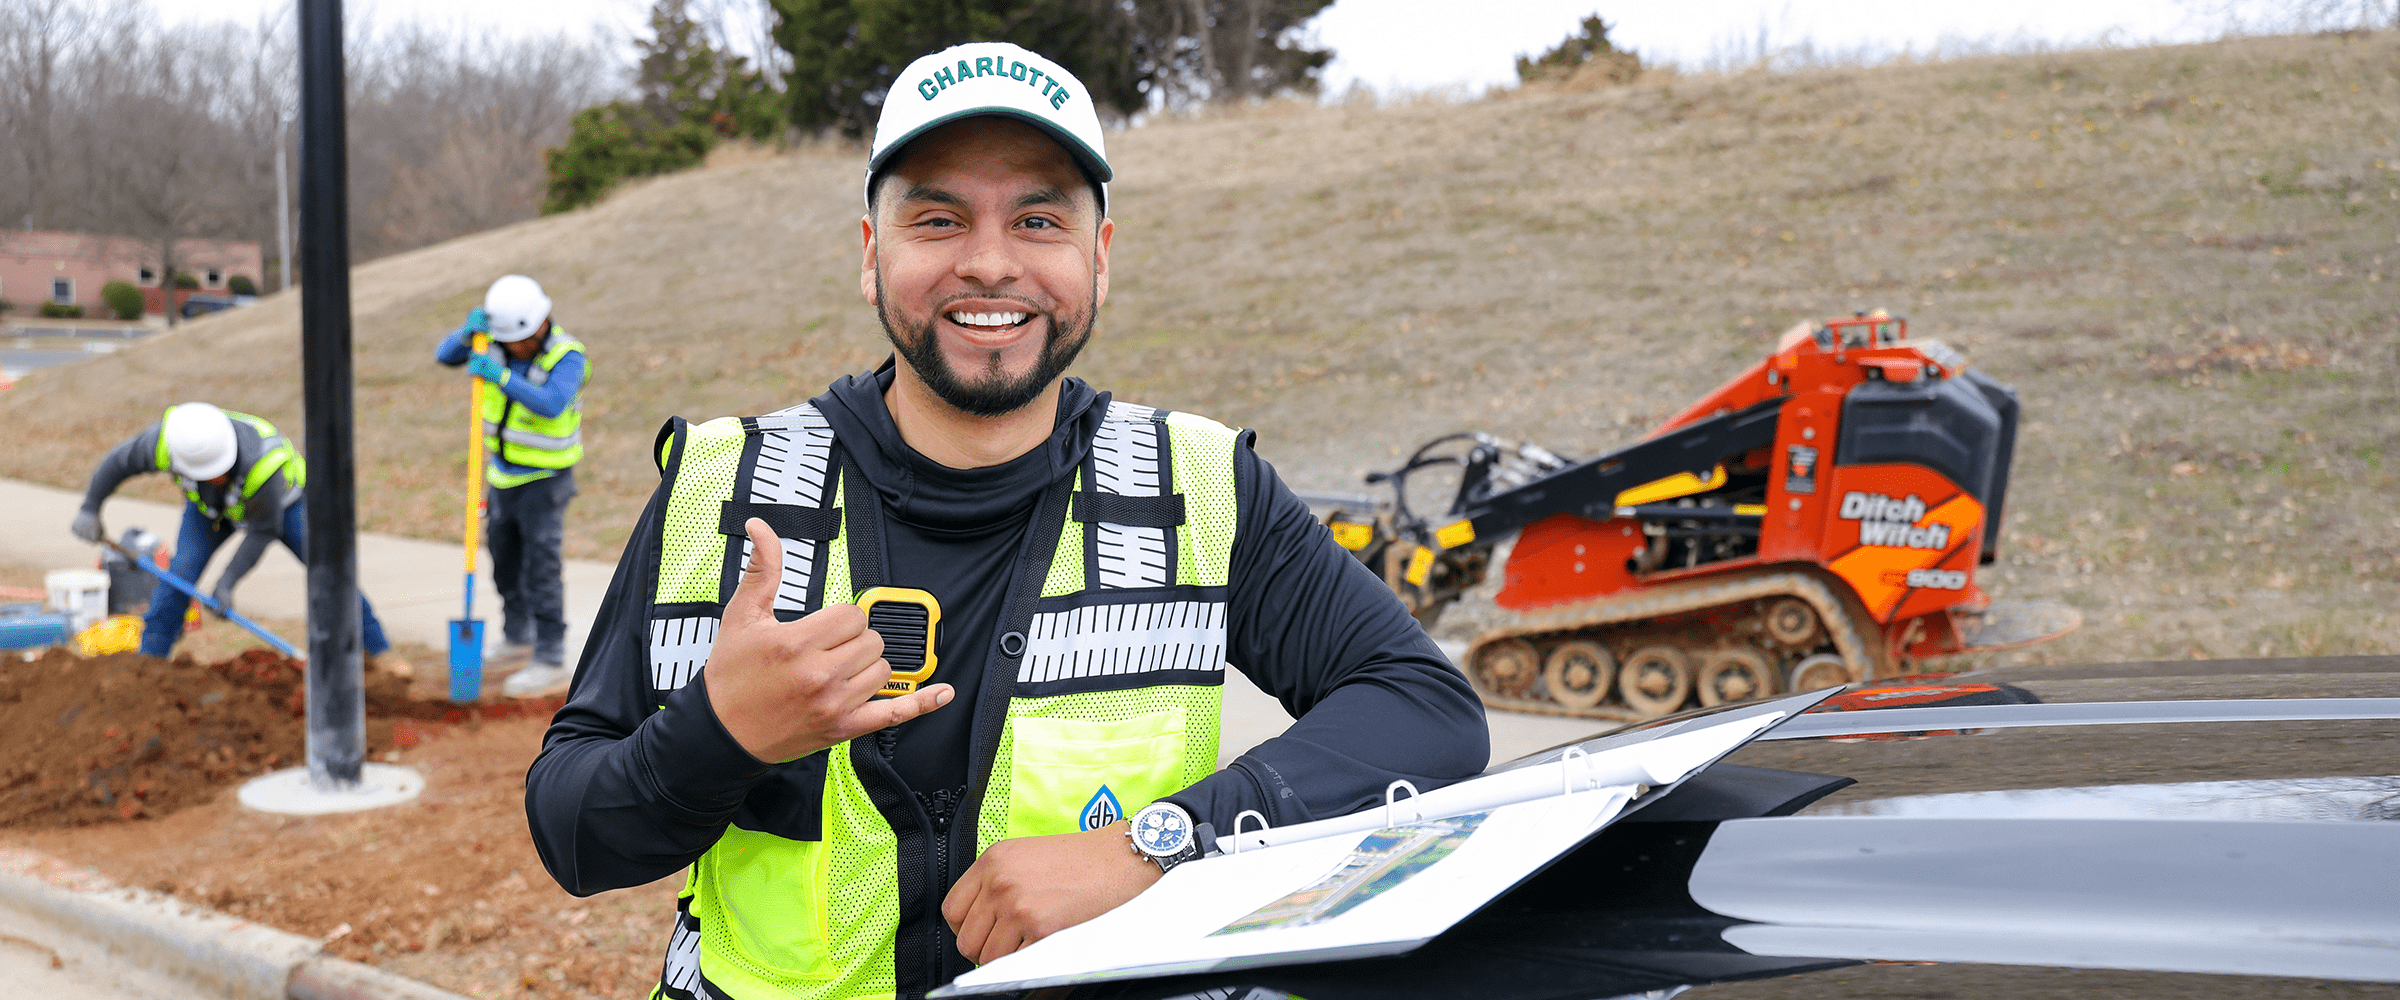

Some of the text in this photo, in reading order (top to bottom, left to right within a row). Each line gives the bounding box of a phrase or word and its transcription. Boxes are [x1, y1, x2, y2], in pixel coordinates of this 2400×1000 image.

[918, 56, 1070, 111] CHARLOTTE
[1840, 491, 1926, 523] Ditch
[1860, 519, 1951, 550] Witch
[883, 682, 911, 691] WALT
